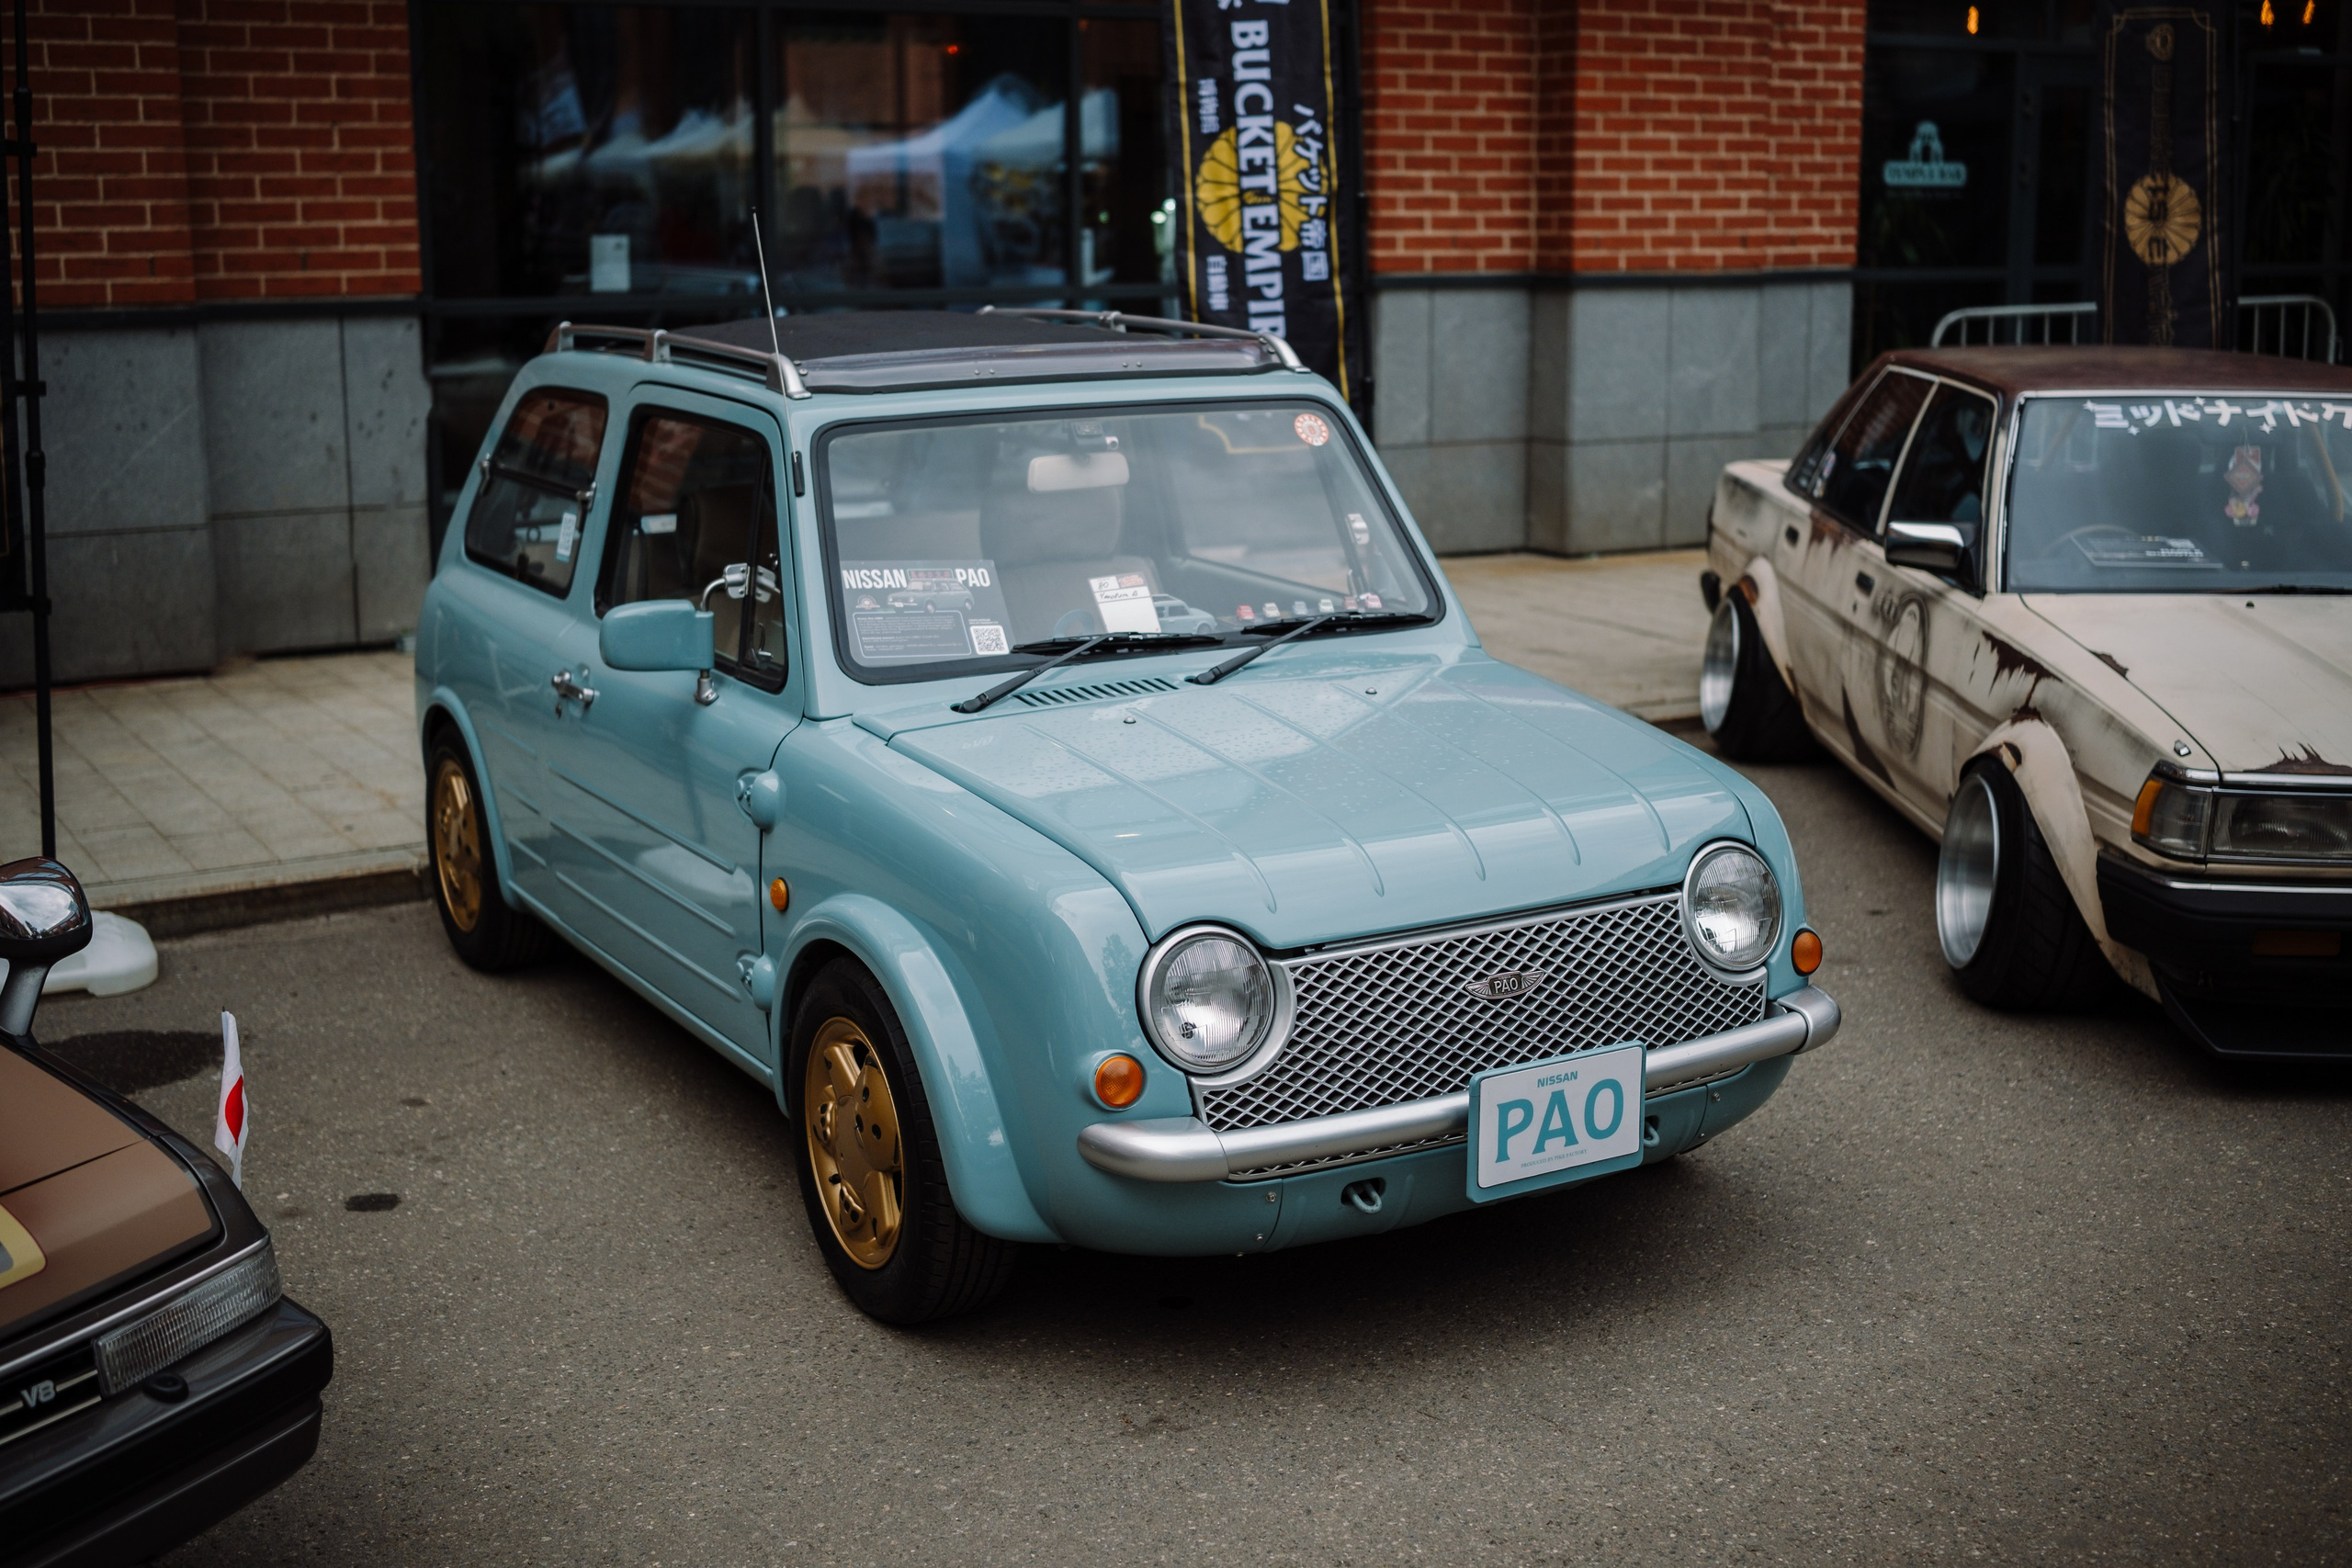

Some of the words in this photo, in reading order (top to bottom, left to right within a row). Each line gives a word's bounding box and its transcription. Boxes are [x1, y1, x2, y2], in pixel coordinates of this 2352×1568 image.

[1231, 20, 1278, 196] BUCKET
[1293, 103, 1329, 282] バケット帝国
[842, 569, 908, 590] NISSAN
[955, 568, 991, 588] PAO
[1493, 977, 1519, 995] PAO
[1537, 1070, 1578, 1089] NISSAN
[1496, 1078, 1623, 1163] PAO
[1521, 1158, 1547, 1168] PRODUCED
[1566, 1149, 1588, 1158] FACTORY
[21, 1381, 56, 1407] V8
